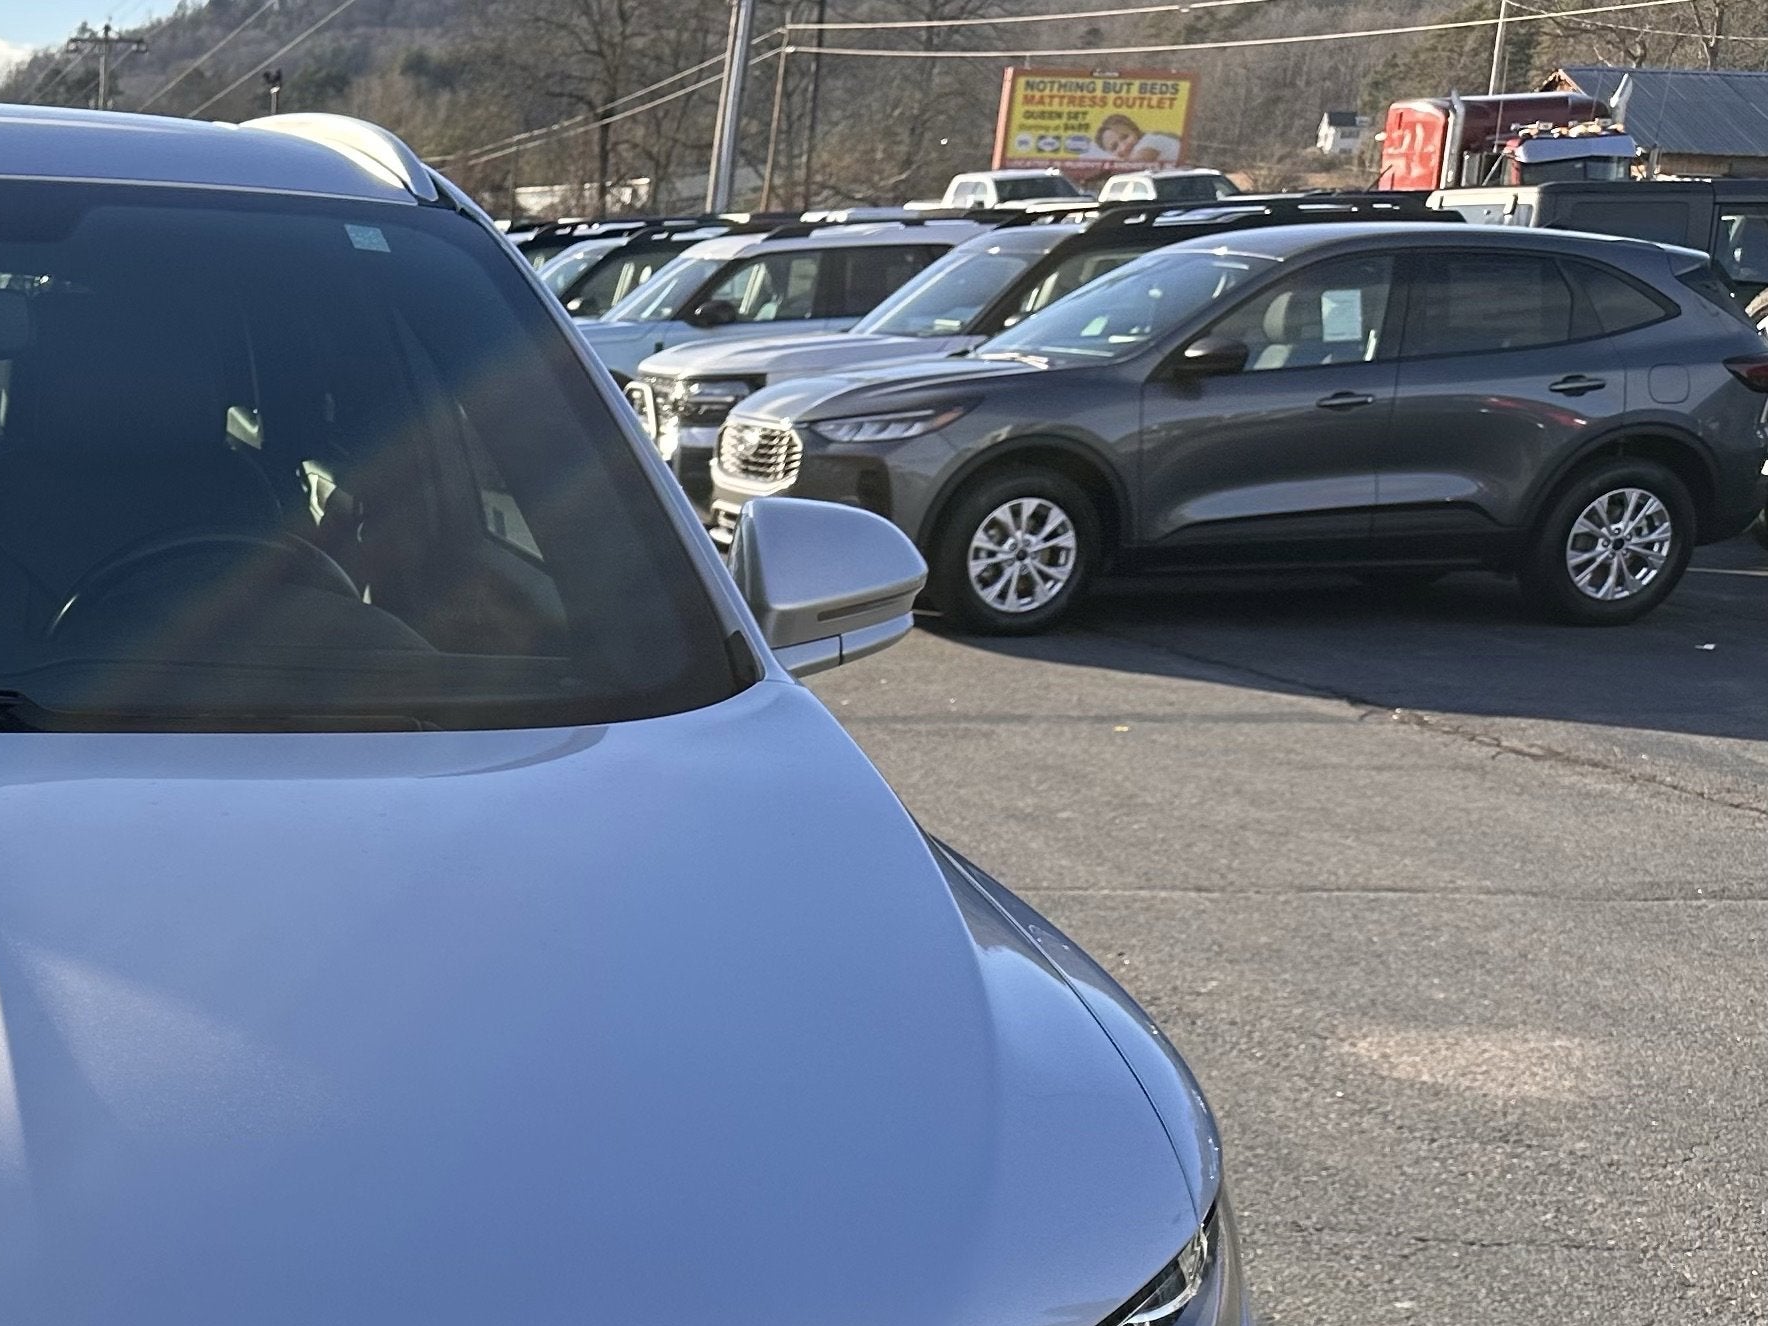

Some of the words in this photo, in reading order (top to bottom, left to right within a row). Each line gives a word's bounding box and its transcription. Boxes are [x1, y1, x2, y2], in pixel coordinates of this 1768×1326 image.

[1024, 80, 1097, 94] NOTHING
[1102, 81, 1134, 94] BUT
[1138, 82, 1179, 95] BEDS
[1021, 94, 1108, 108] MATTRESS
[1112, 96, 1178, 110] OUTLET
